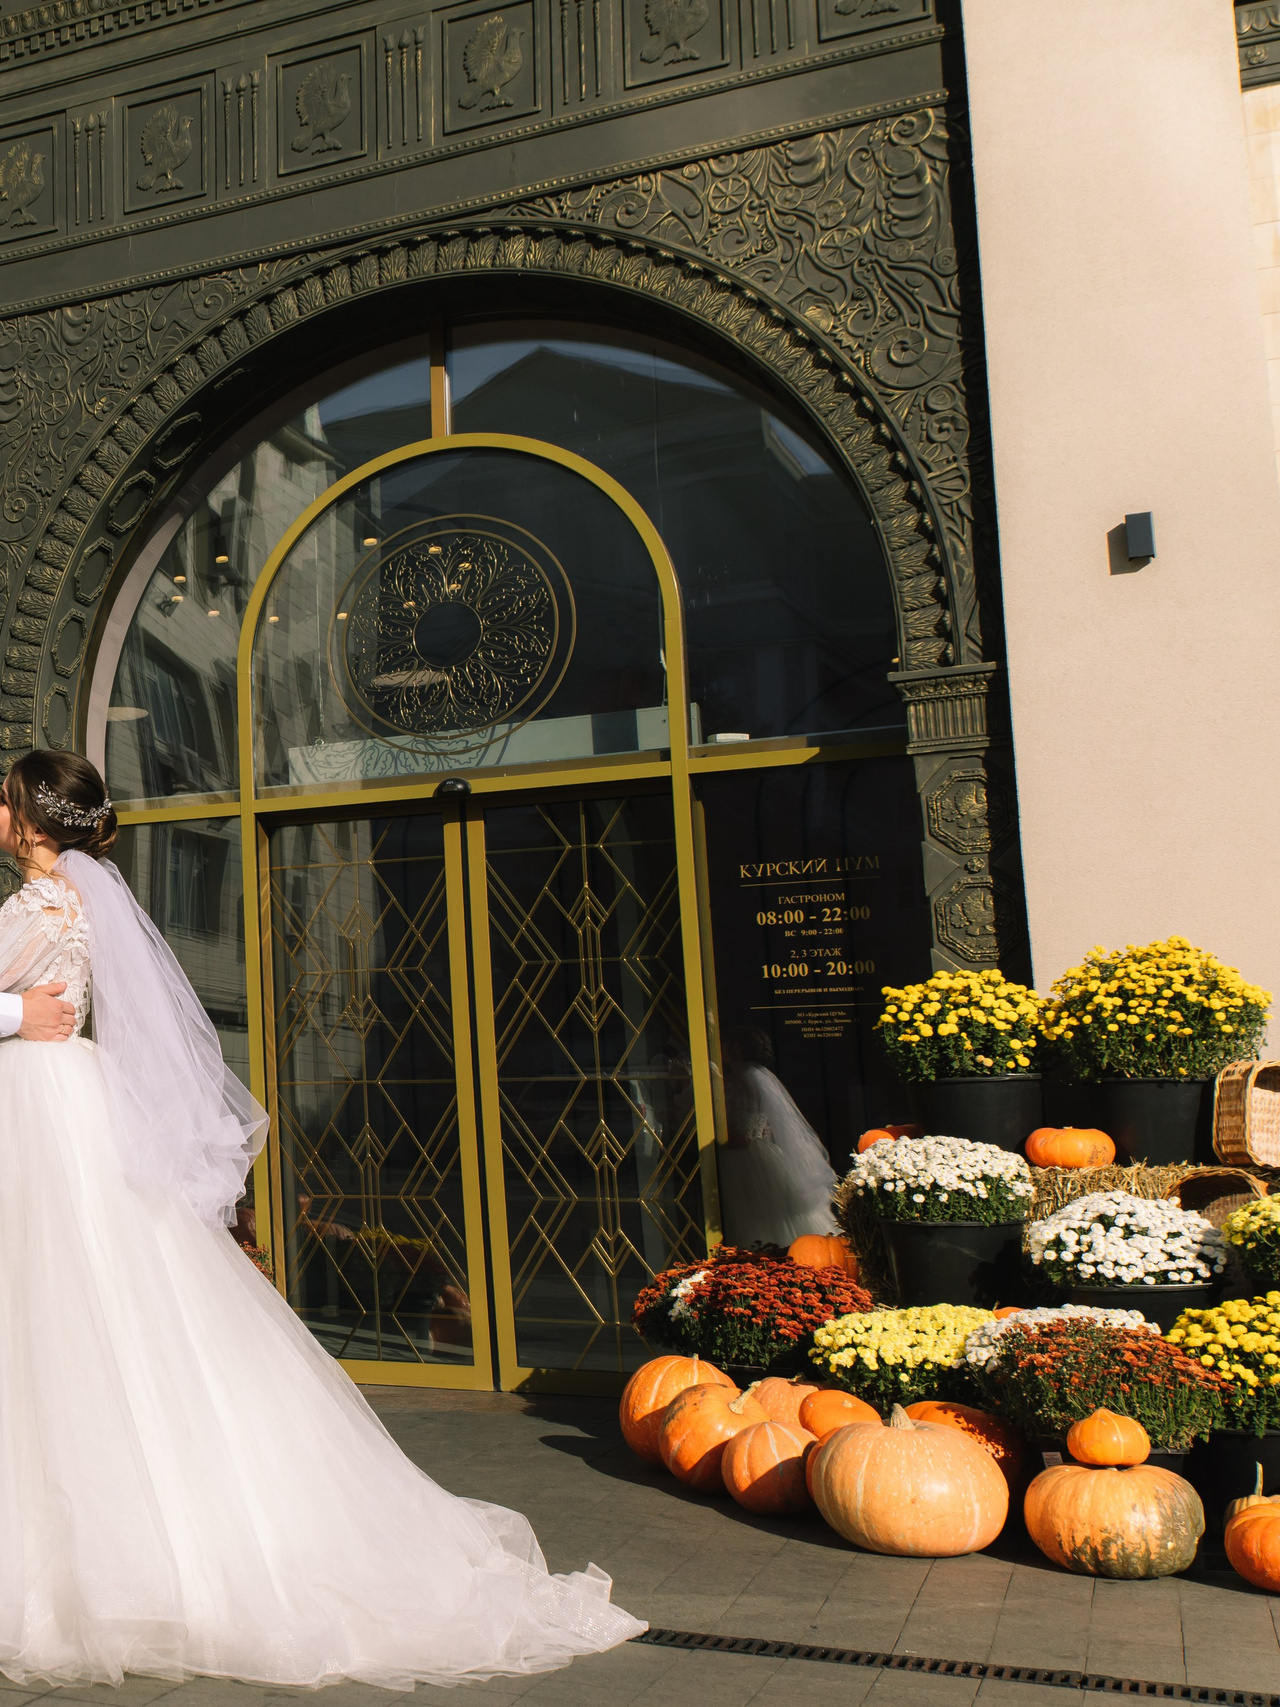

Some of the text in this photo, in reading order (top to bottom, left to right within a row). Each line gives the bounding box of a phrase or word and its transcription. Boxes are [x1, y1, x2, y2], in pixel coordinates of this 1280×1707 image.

[739, 855, 880, 878] КУРСКИЙ ЦУМ
[778, 892, 845, 905] ГАСТРОНОМ
[756, 909, 804, 926] 08:00
[821, 906, 870, 922] 22:00
[800, 928, 817, 936] 9:00
[823, 927, 844, 935] 22:00
[790, 947, 842, 959] 2, 3 ЭТАЖ
[761, 962, 809, 979] 10:00
[826, 959, 875, 976] 20:00
